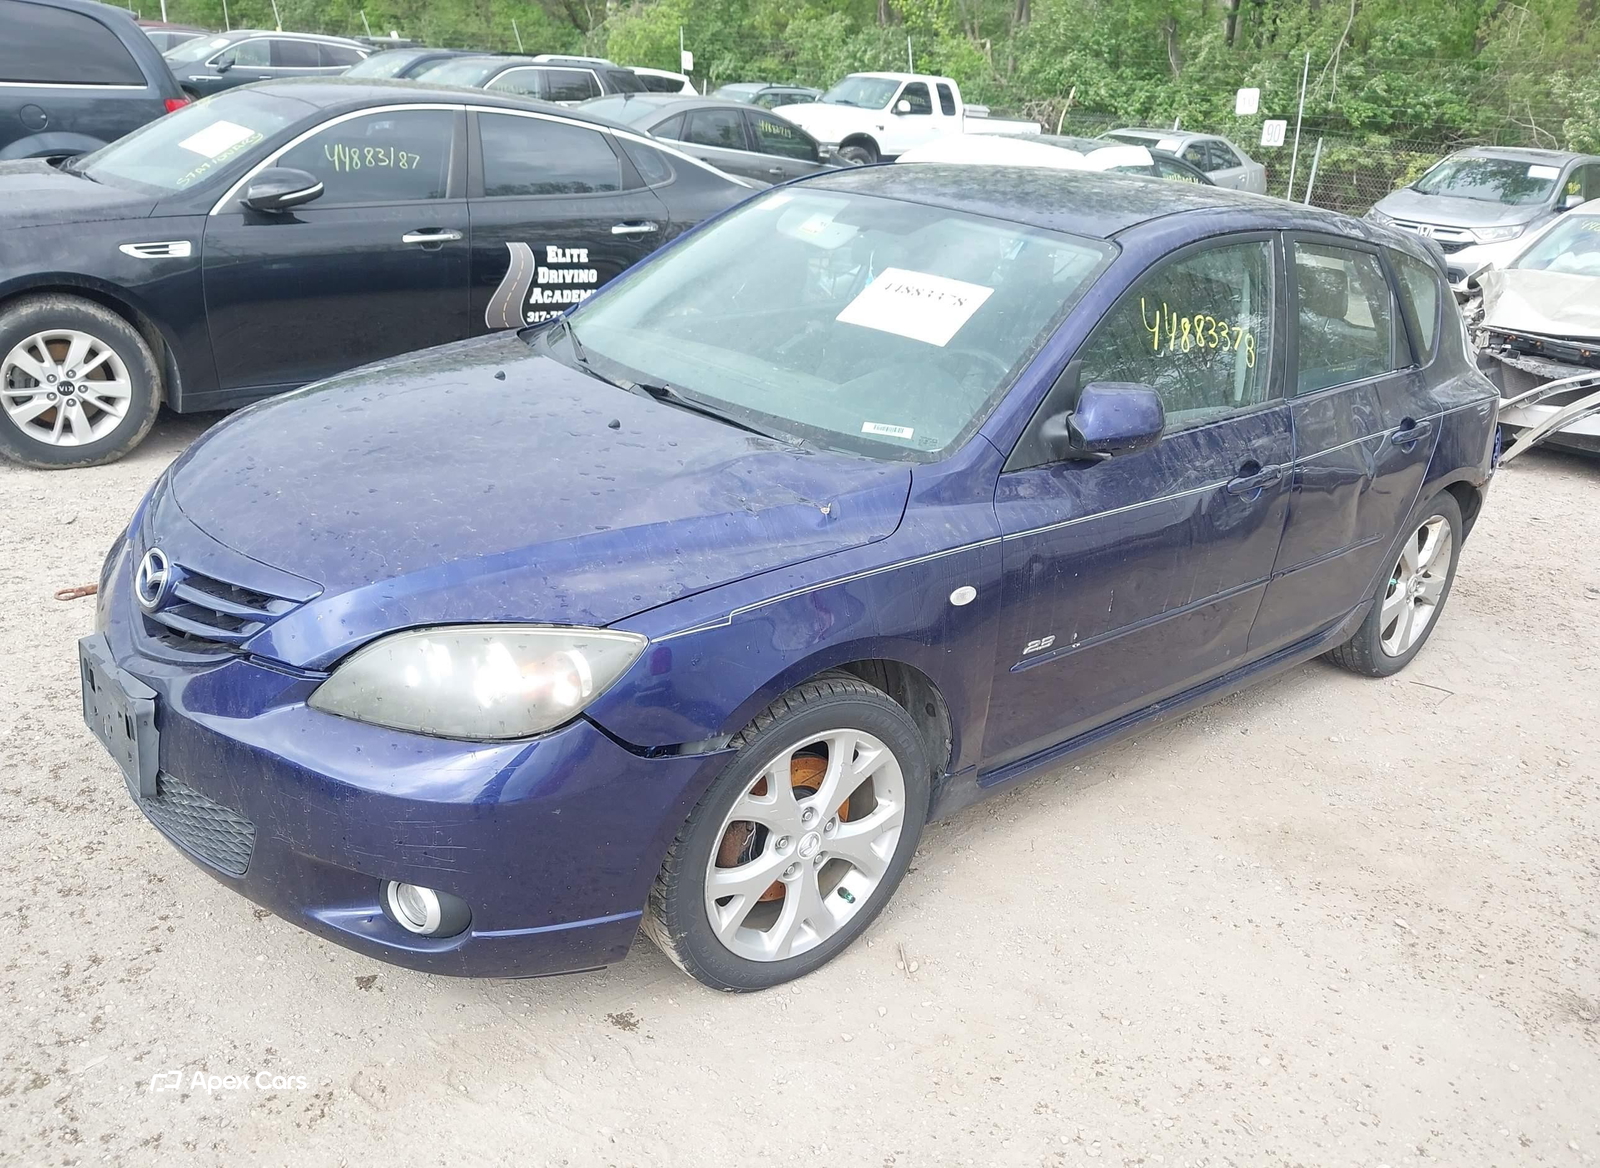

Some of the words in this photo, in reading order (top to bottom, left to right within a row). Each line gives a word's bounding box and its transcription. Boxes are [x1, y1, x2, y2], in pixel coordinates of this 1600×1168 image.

[1266, 123, 1281, 143] 90
[324, 144, 420, 172] 44883187
[546, 245, 589, 263] ELITE
[537, 266, 598, 284] DRIVING
[529, 287, 598, 304] ACADEM
[1141, 297, 1255, 369] 44883378
